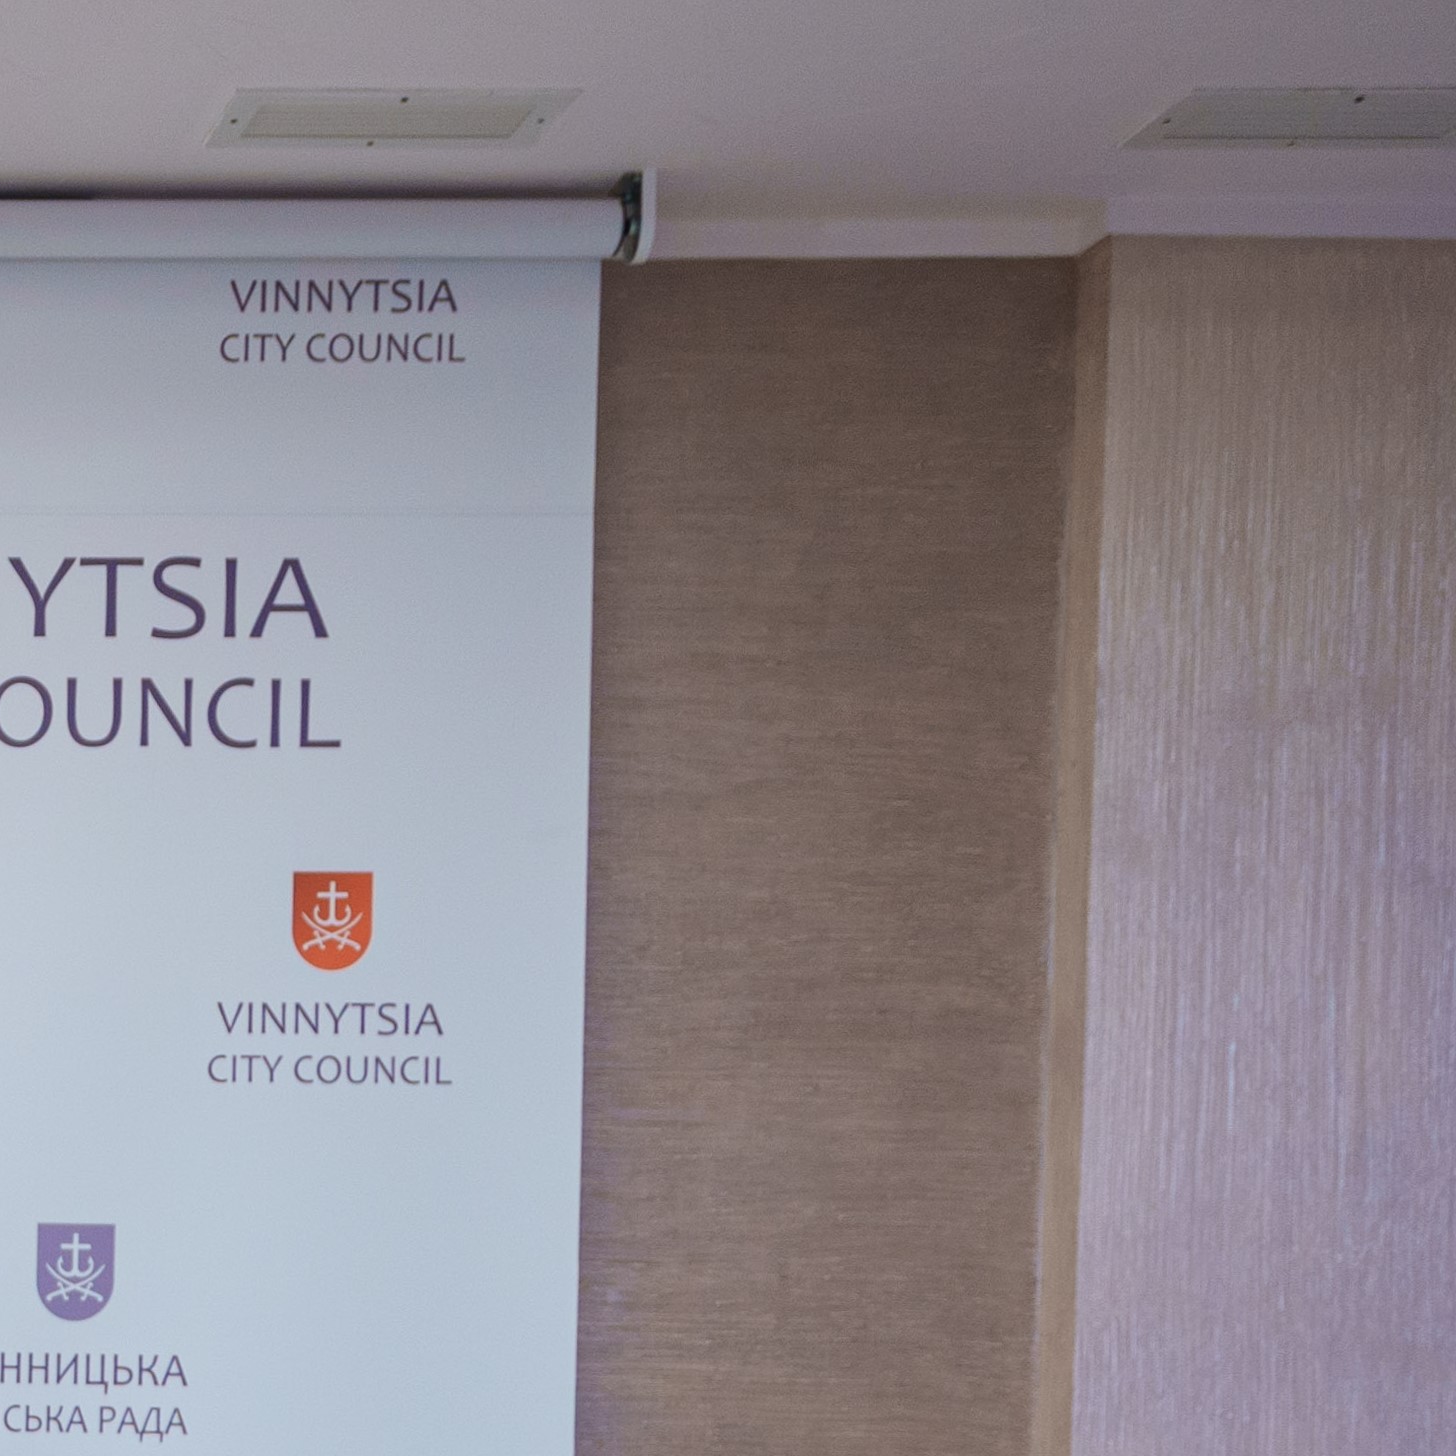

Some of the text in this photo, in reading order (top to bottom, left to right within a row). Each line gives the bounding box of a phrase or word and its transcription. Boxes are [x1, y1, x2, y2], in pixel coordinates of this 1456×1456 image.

[230, 278, 458, 314] VINNYTSIA
[219, 332, 466, 364] CITY COUNCIL
[217, 1001, 444, 1037] VINNYTSIA
[207, 1054, 453, 1086] CITY COUNCIL
[98, 1405, 188, 1443] РАДА
